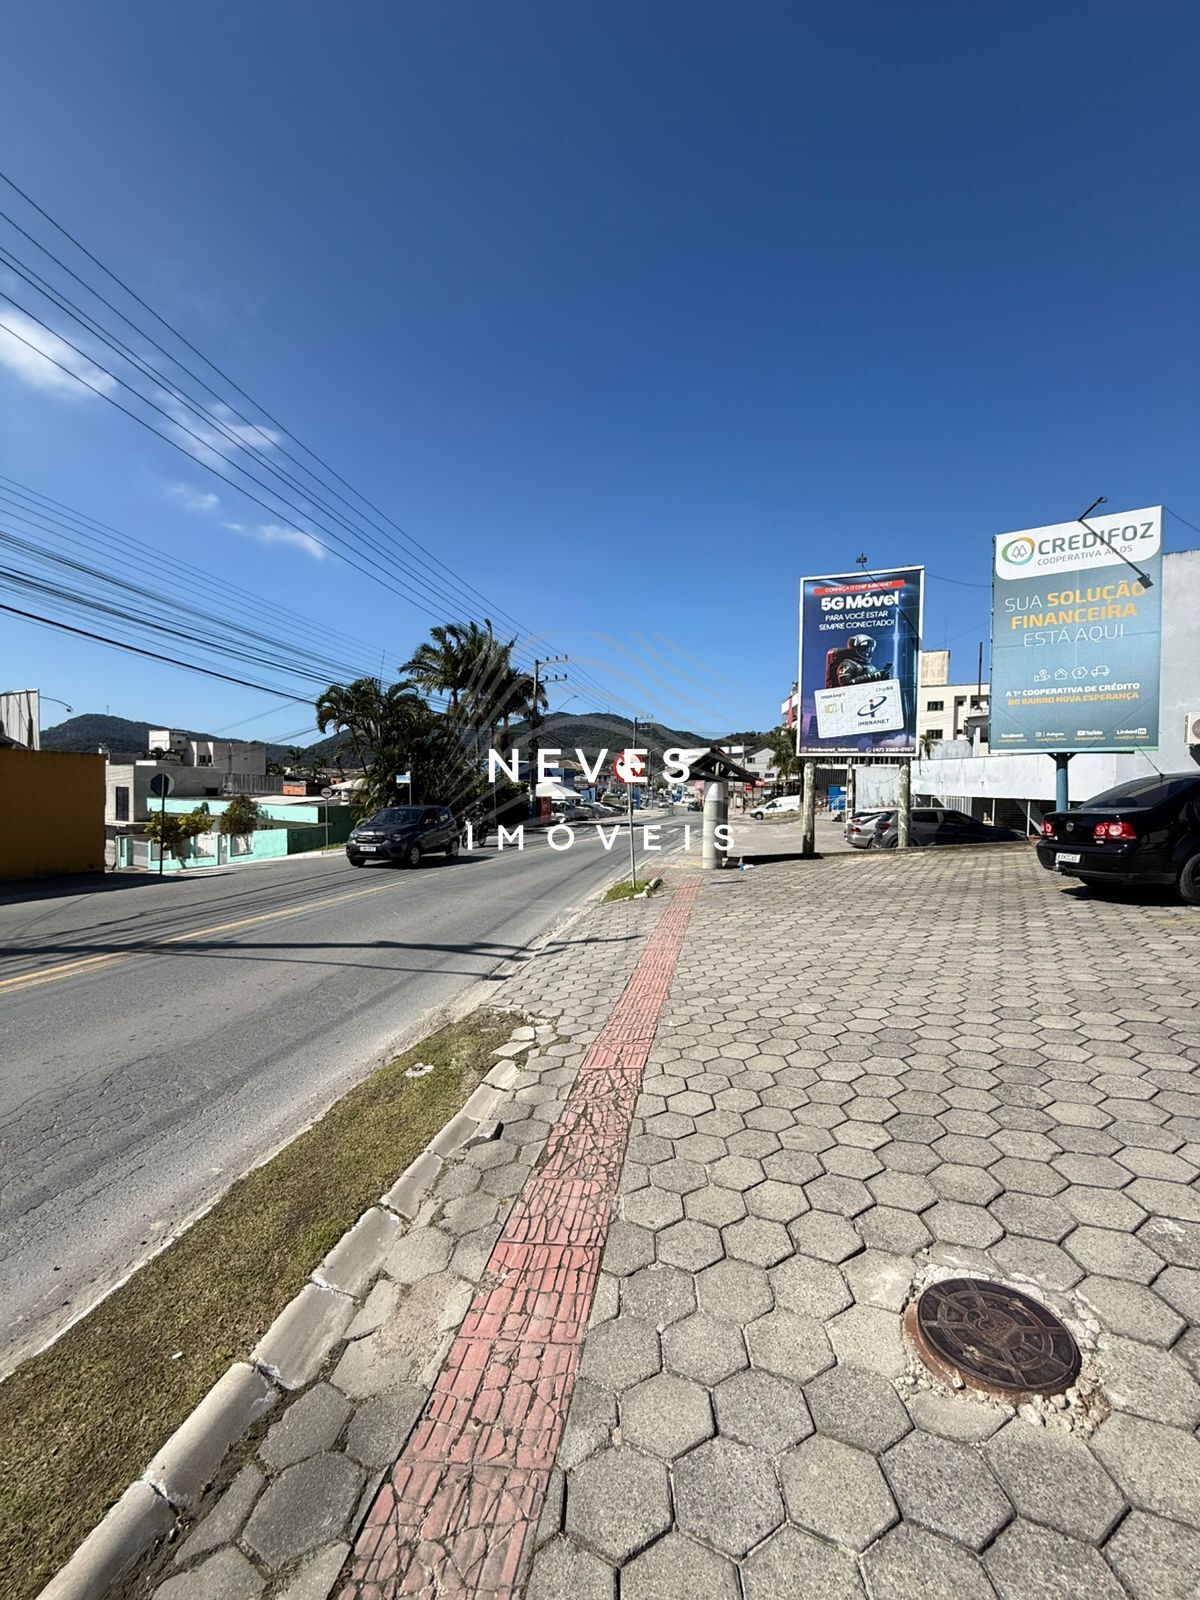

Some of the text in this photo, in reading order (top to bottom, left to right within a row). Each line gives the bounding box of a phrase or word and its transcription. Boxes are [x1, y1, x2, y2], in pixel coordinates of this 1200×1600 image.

[1038, 522, 1154, 556] CREDIFOZ
[1037, 545, 1133, 566] COOPERATIVA AOS
[821, 591, 899, 611] 5G Móvel
[1005, 580, 1147, 612] SUA SOLUÇÃO
[819, 619, 894, 631] SEMPRE CONECTADO!
[825, 610, 888, 621] PARA VOCÊ ESTAR
[1011, 602, 1137, 630] FINANCEIRA
[1024, 624, 1124, 647] ESTÁ AQUI
[1023, 687, 1083, 696] COOPERATIVA
[1099, 682, 1140, 691] CRÉDITO
[1083, 692, 1139, 702] ESPERANÇA
